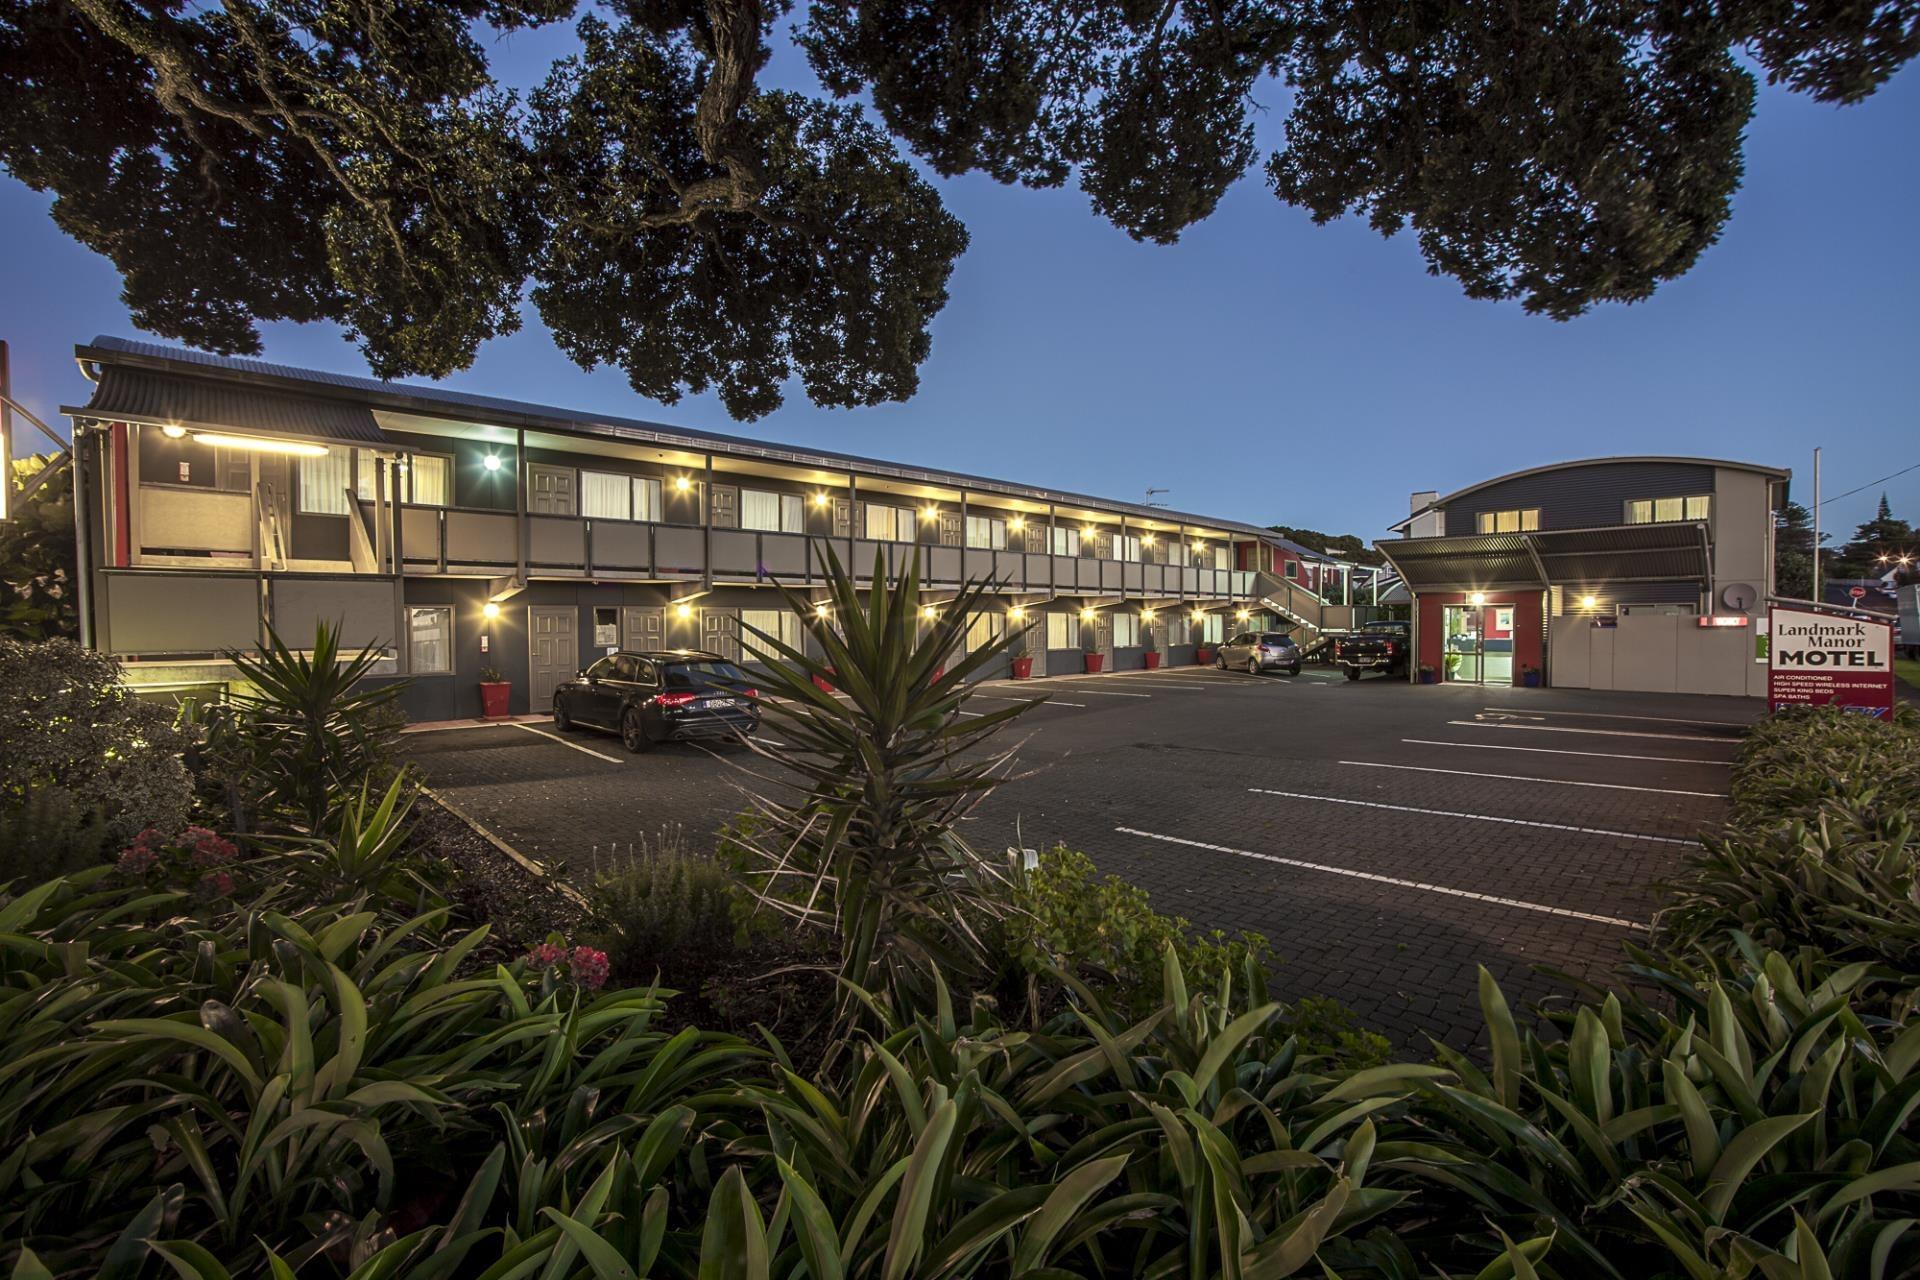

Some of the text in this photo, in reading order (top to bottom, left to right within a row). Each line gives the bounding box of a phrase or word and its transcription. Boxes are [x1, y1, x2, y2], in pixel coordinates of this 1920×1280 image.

[1779, 623, 1866, 636] Landmark
[1807, 636, 1866, 648] Manor
[1779, 650, 1884, 666] MOTEL
